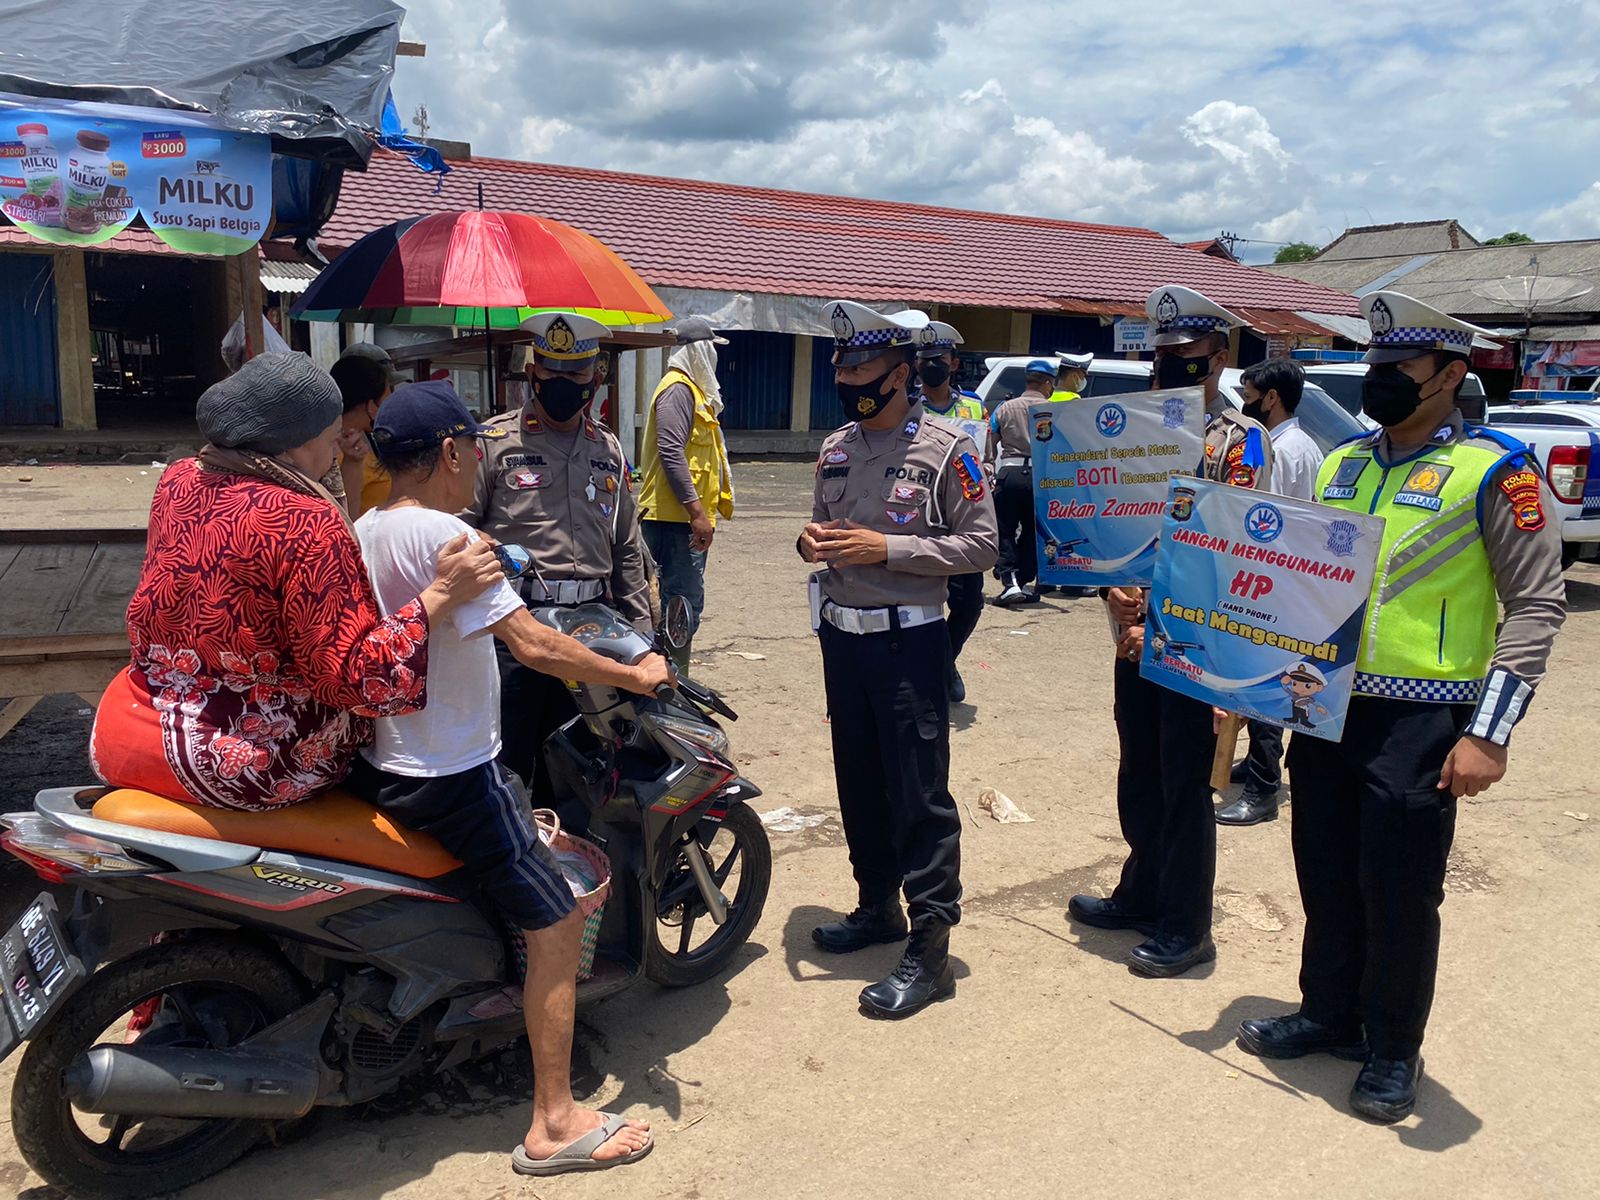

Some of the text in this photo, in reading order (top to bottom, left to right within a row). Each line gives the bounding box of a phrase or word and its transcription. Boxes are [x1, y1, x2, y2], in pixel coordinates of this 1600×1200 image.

[142, 142, 184, 155] Rp 3000
[21, 157, 58, 170] MILKU
[68, 168, 107, 187] MILKU
[105, 196, 133, 208] COKLAT
[159, 176, 254, 211] MILKU
[6, 204, 46, 222] STROBERI
[94, 210, 127, 221] PREMIUM
[152, 211, 261, 235] Susu Sapi Belgia
[1051, 448, 1108, 463] Mengendarai
[1110, 445, 1146, 459] Sepeda
[884, 466, 934, 485] POLRI
[1076, 466, 1118, 487] BOTI
[1047, 498, 1167, 519] Bukan Zamann
[1396, 493, 1439, 510] UNIT LAKA
[1056, 557, 1092, 566] BERSATU
[1172, 528, 1356, 584] JANGAN MENGGUNAKAN
[1229, 569, 1274, 601] HP
[1222, 602, 1244, 613] HAND
[1244, 608, 1272, 622] PHONE
[1162, 597, 1339, 664] Saat Mengemudi
[1163, 655, 1204, 676] BERSATU
[250, 865, 346, 894] VARIO
[20, 905, 65, 997] BE 6449 YL
